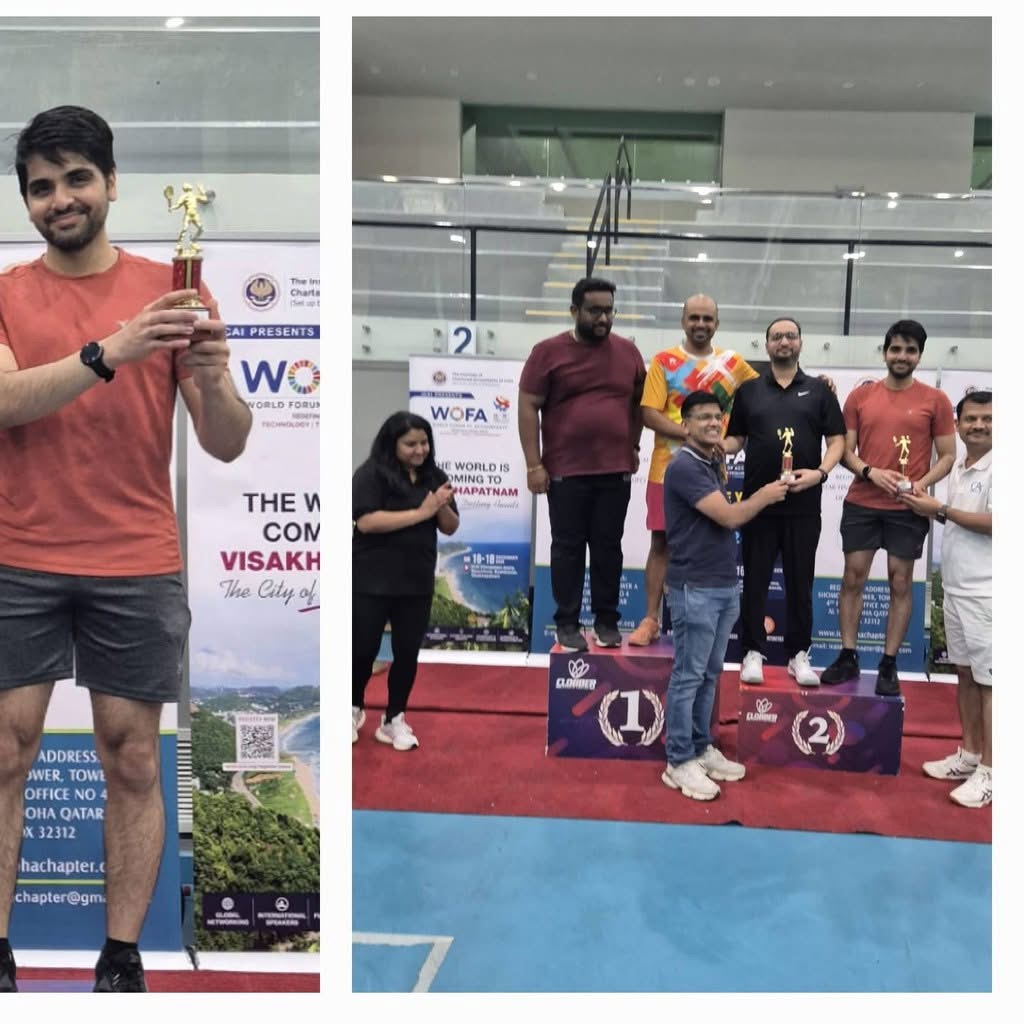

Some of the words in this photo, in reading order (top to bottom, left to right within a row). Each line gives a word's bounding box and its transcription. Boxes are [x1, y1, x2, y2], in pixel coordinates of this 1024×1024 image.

[250, 328, 314, 337] PRESENTS
[453, 327, 472, 354] 2
[241, 359, 320, 394] WO
[430, 406, 488, 422] WOFA
[455, 462, 496, 472] WORLD
[500, 463, 510, 472] IS
[488, 476, 502, 484] TO
[243, 493, 296, 512] THE
[263, 522, 320, 542] COM
[219, 579, 250, 600] The
[258, 579, 296, 606] City
[299, 580, 316, 606] of
[620, 690, 644, 732] 1
[808, 716, 830, 744] 2
[69, 769, 106, 782] TOWE
[24, 788, 70, 800] OFFICE
[74, 788, 97, 800] NO
[100, 788, 108, 800] 4
[25, 807, 55, 820] OHA
[59, 807, 105, 821] QATAR
[38, 826, 76, 839] 32312
